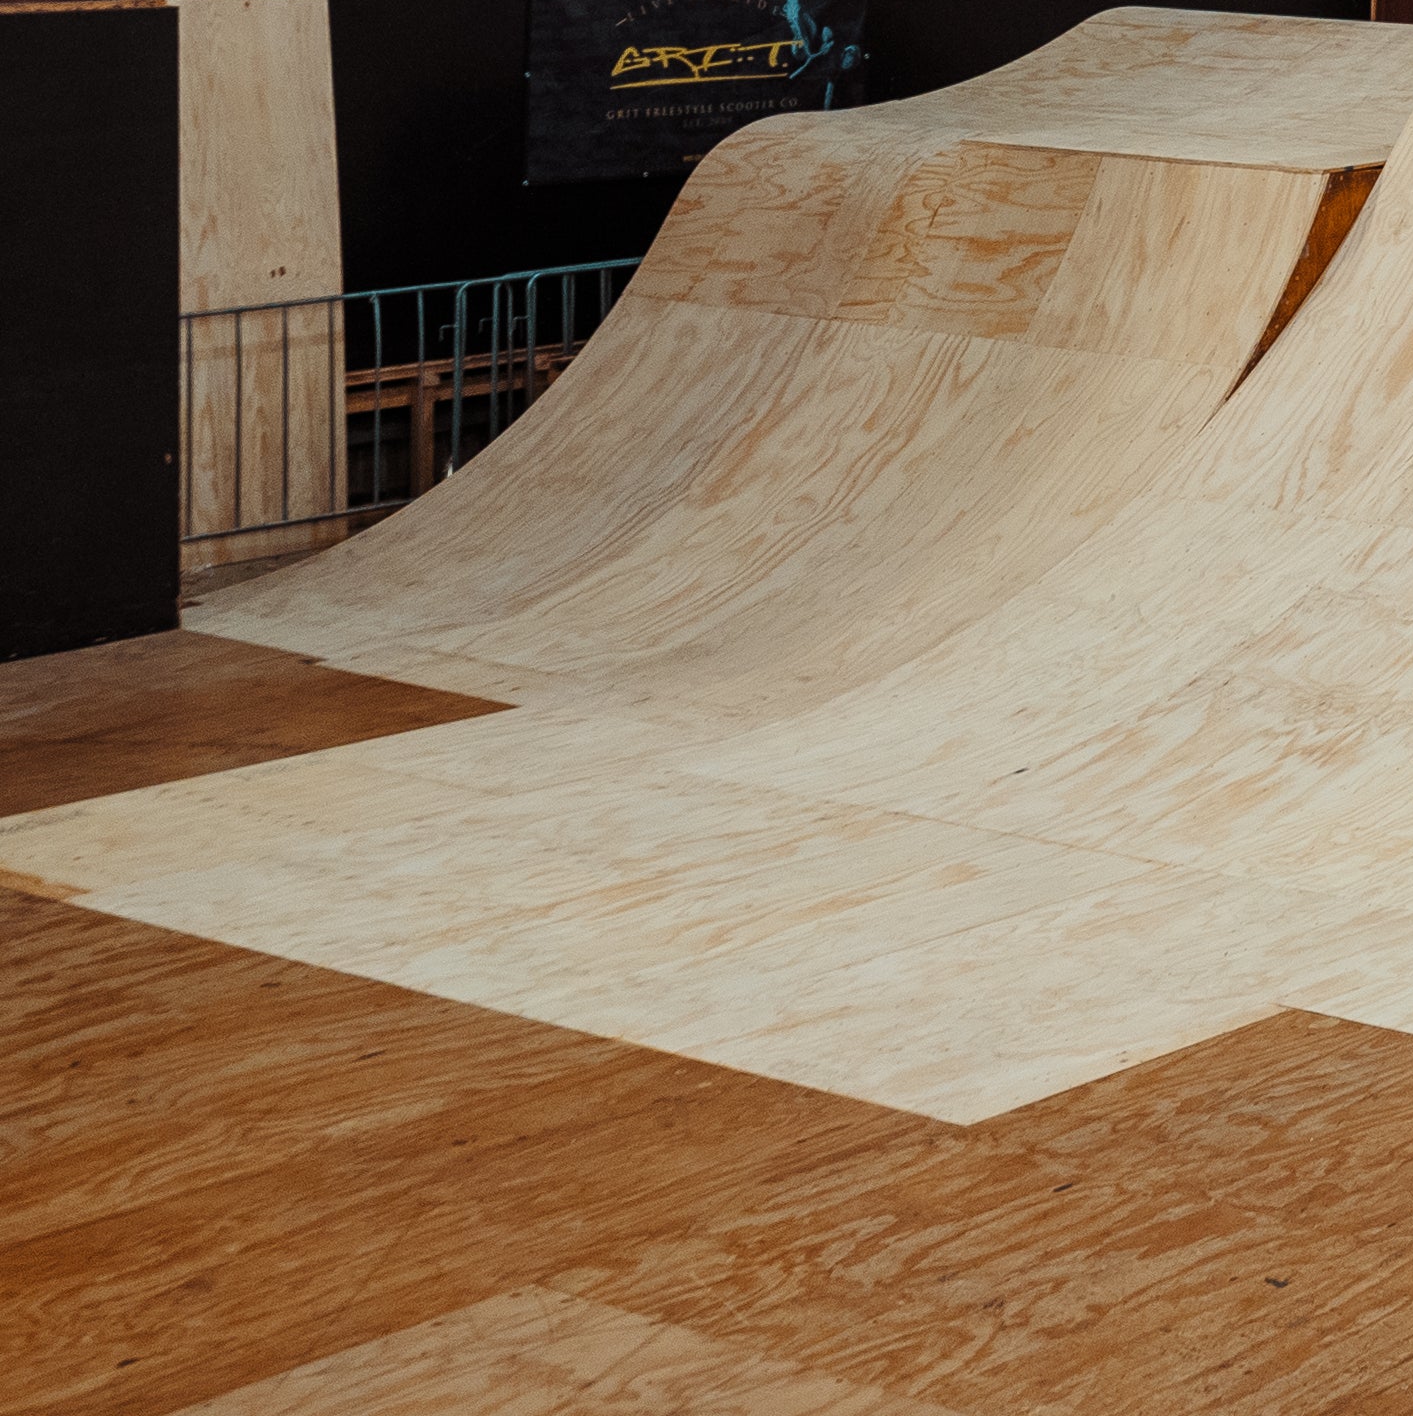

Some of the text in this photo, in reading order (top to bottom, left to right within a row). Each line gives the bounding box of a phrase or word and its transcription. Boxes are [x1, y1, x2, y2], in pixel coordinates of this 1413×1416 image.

[606, 108, 638, 120] GRIT
[646, 104, 713, 117] FREESTYLE
[719, 99, 775, 112] SCOOTER
